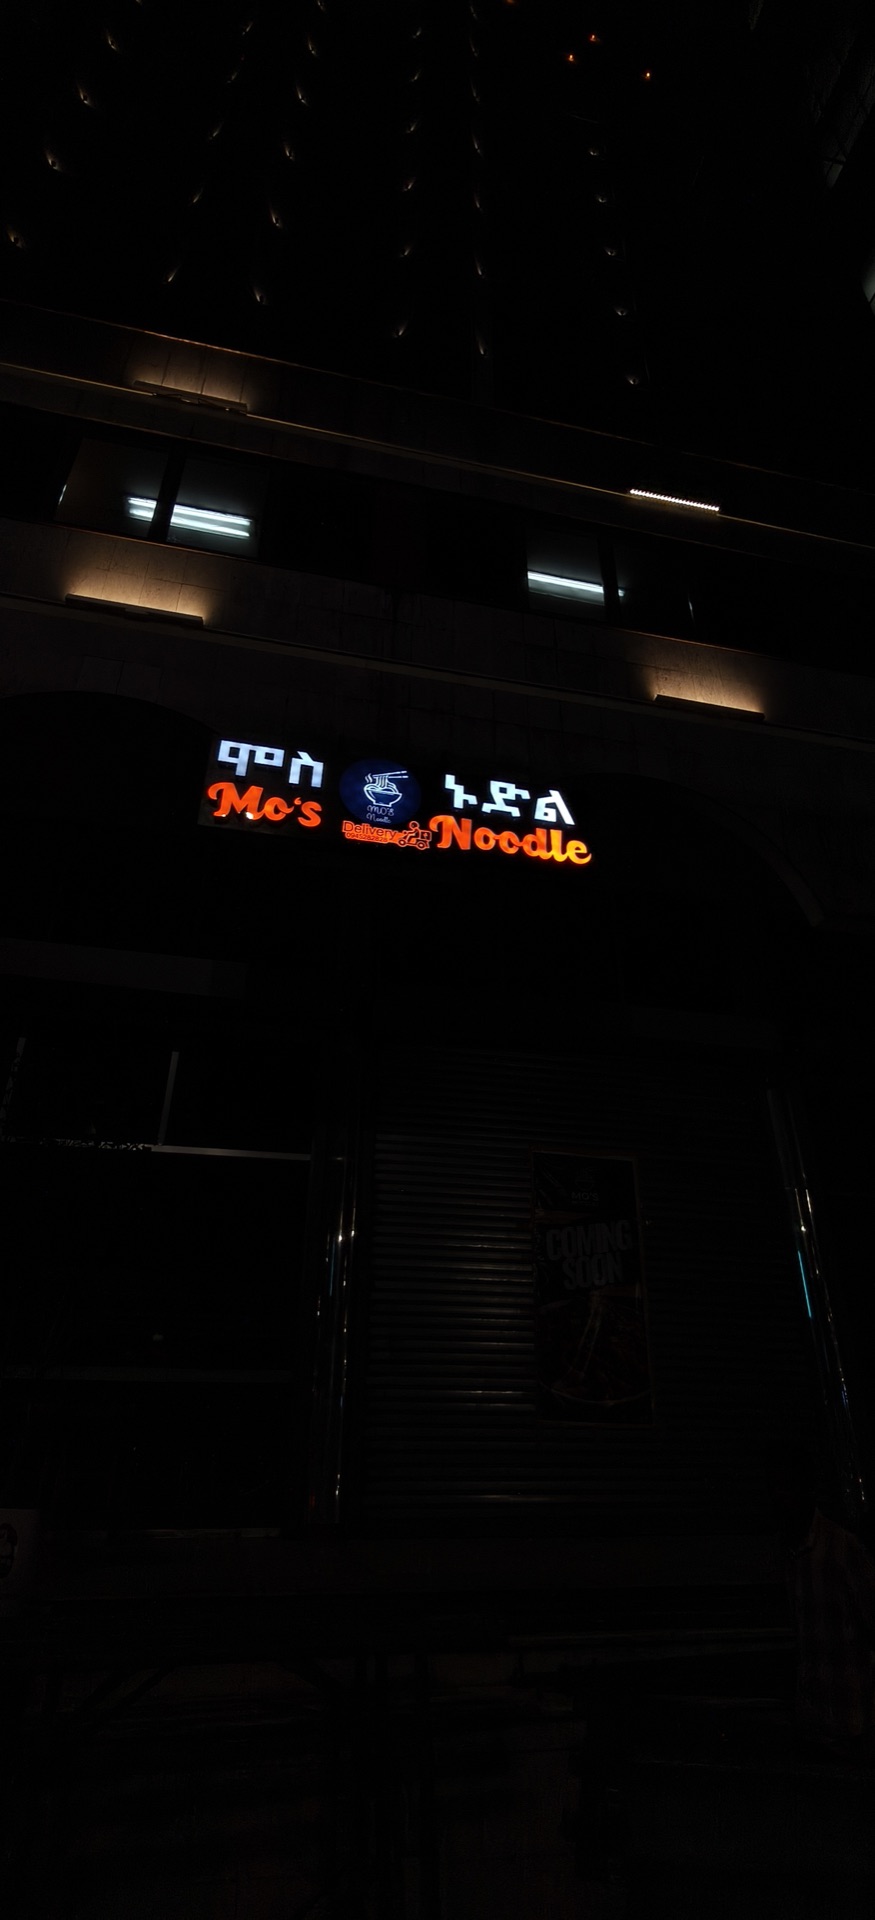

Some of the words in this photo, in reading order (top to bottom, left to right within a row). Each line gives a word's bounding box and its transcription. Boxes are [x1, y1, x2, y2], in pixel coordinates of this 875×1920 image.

[217, 740, 324, 788] ሞስ
[445, 774, 575, 825] ኑድል
[208, 782, 322, 827] Mo's
[429, 815, 592, 864] Noodle
[343, 820, 397, 840] Delivery
[546, 1219, 633, 1261] COMING
[562, 1251, 624, 1290] SOON
